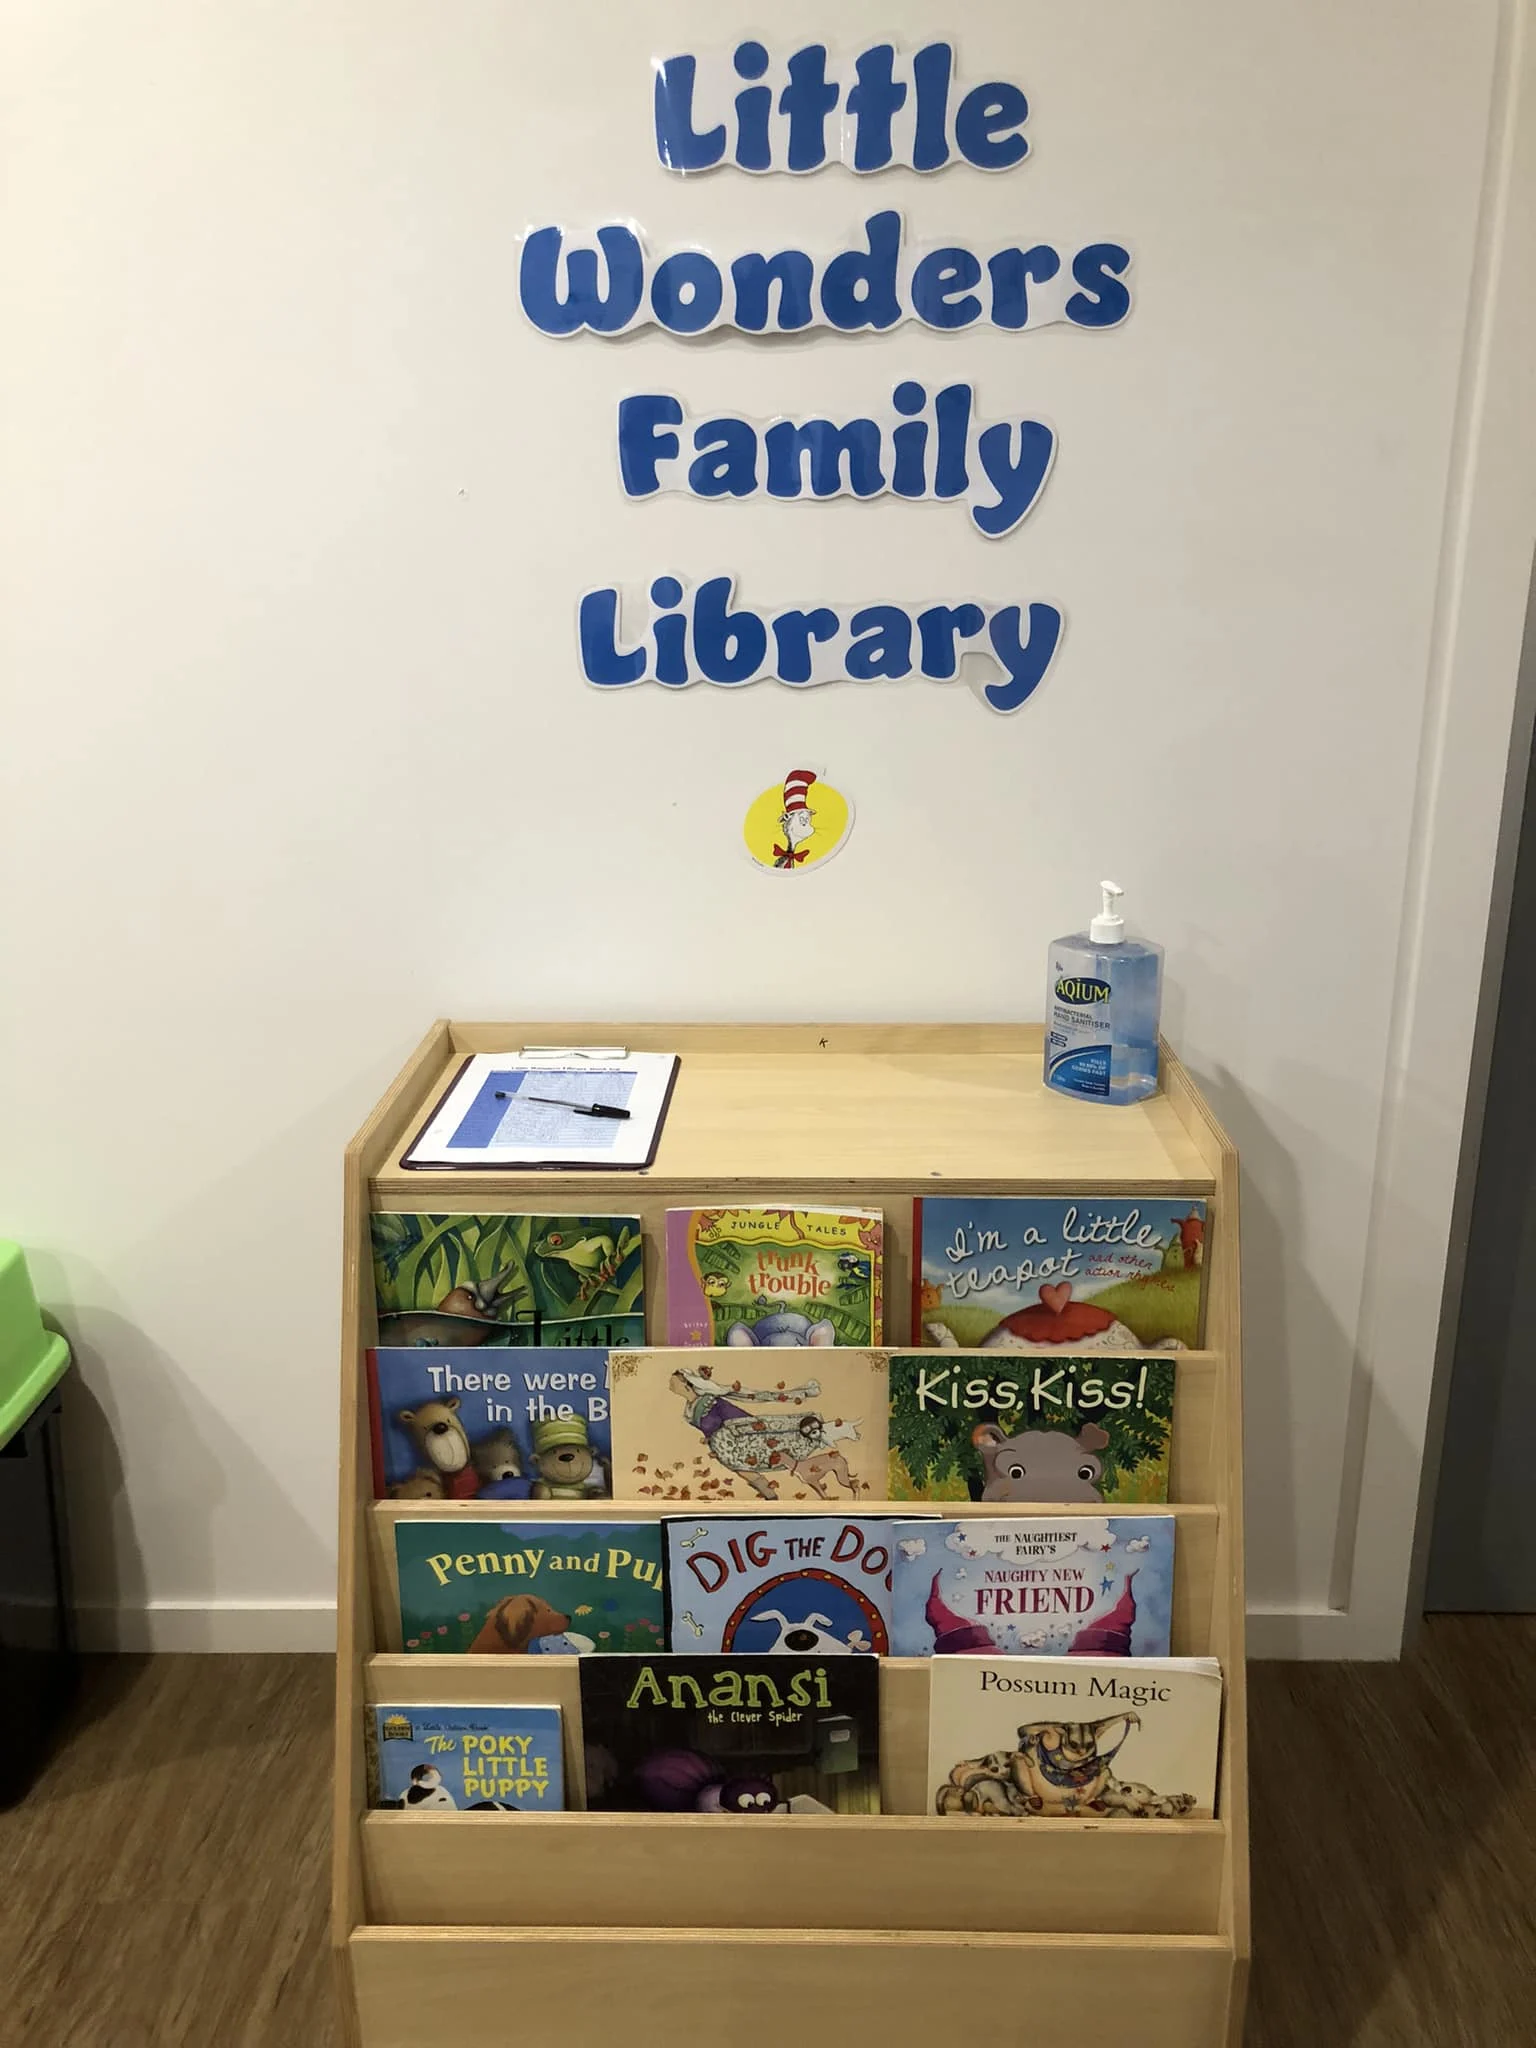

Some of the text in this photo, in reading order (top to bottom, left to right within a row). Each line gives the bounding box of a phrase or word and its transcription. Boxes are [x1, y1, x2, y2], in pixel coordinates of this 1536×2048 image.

[655, 41, 1029, 171] Little
[519, 210, 1131, 334] Wonders
[618, 381, 1053, 535] Family
[579, 576, 1061, 712] Library
[730, 1220, 847, 1236] JUNGLE TALES
[945, 1206, 1163, 1263] I'm a little
[757, 1250, 820, 1276] trunk
[946, 1248, 1083, 1300] teapot
[747, 1271, 832, 1298] trouble
[427, 1364, 512, 1393] There
[523, 1372, 597, 1391] were
[916, 1364, 1148, 1411] Kiss, Kiss!
[486, 1395, 609, 1422] in the B
[994, 1532, 1078, 1544] THE NAUGHTIEST
[1015, 1545, 1057, 1556] FAIRY'S
[426, 1548, 545, 1586] Penny
[549, 1552, 600, 1574] and
[686, 1530, 777, 1593] DIG
[784, 1537, 826, 1560] THE
[984, 1568, 1086, 1583] NAUGHTY NEW
[974, 1586, 1095, 1616] FRIEND
[626, 1666, 832, 1708] Anansi
[979, 1670, 1172, 1706] Possum Magic
[708, 1708, 803, 1727] the Clever Spider
[424, 1733, 533, 1756] The POKY
[463, 1756, 548, 1777] LITTLE
[464, 1778, 549, 1799] PUPPY
